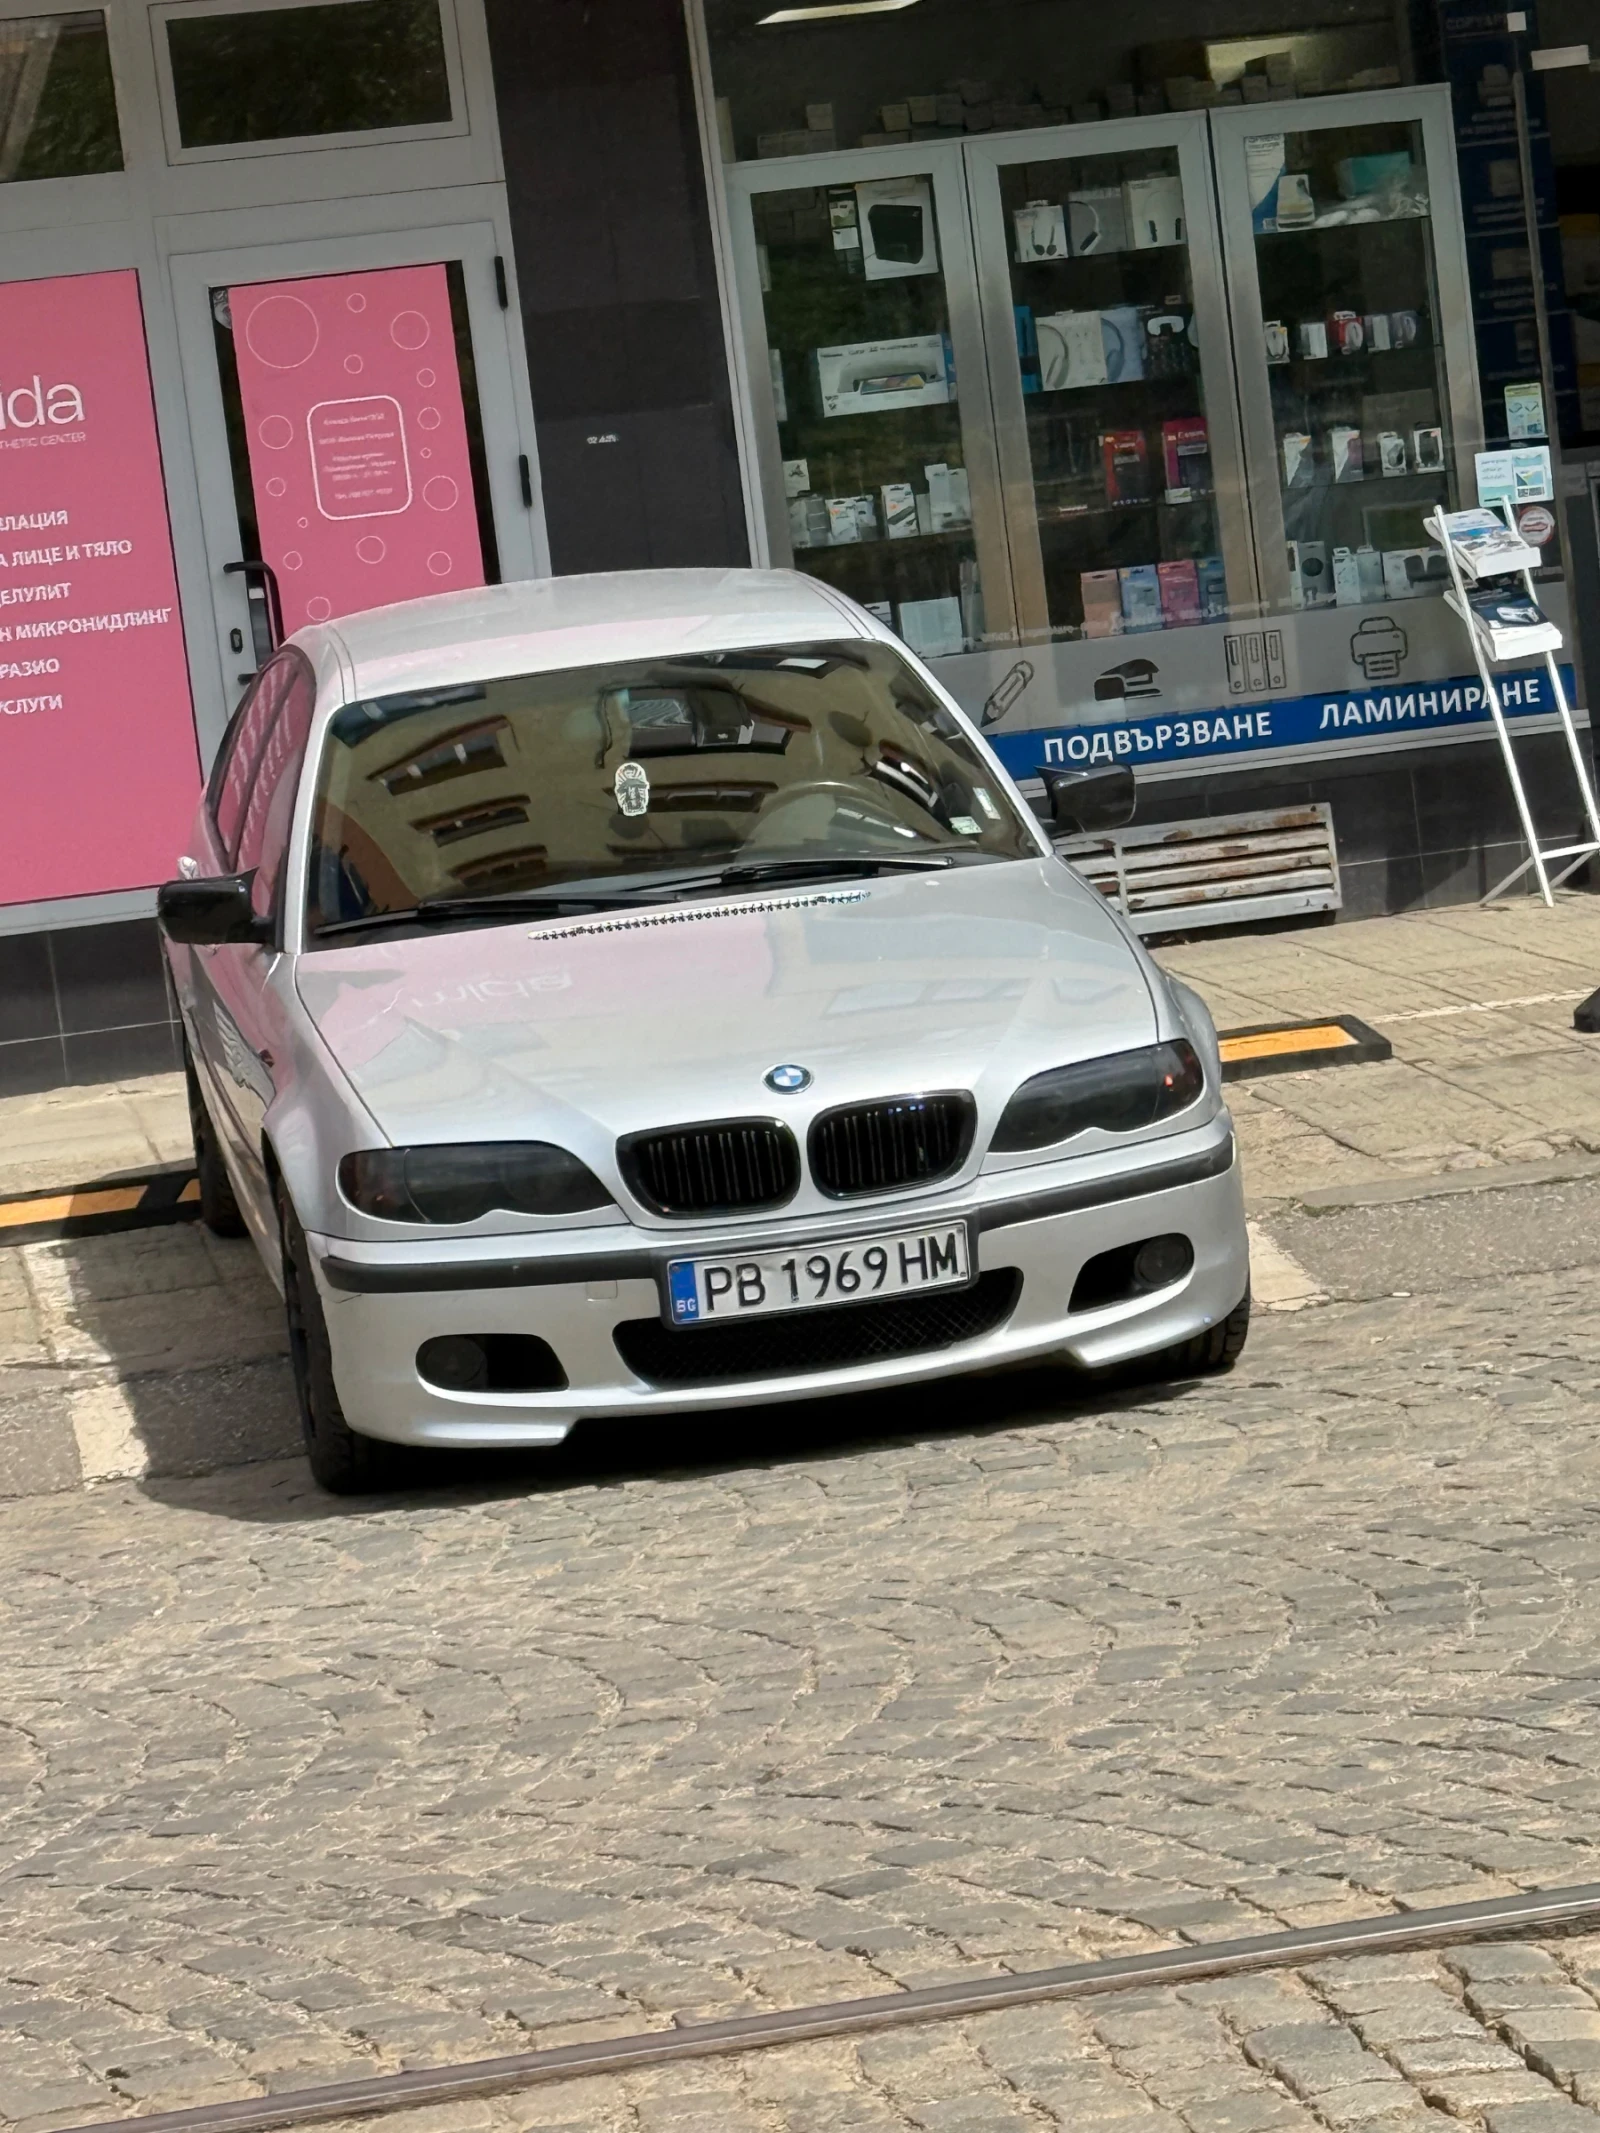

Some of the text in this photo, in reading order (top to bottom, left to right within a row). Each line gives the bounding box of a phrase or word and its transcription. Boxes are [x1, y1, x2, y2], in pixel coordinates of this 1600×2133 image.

[40, 432, 86, 446] CENTER
[12, 547, 63, 567] ЛИЦЕ
[66, 545, 80, 560] И
[82, 540, 132, 558] ТЯЛО
[0, 583, 72, 608] ЕЛУЛИТ
[16, 608, 172, 640] МИКРОНИДЛИНГ
[1044, 711, 1273, 764] ПОДВЪРЗВАНЕ
[780, 1245, 888, 1303] 1969
[675, 1298, 697, 1313] BG
